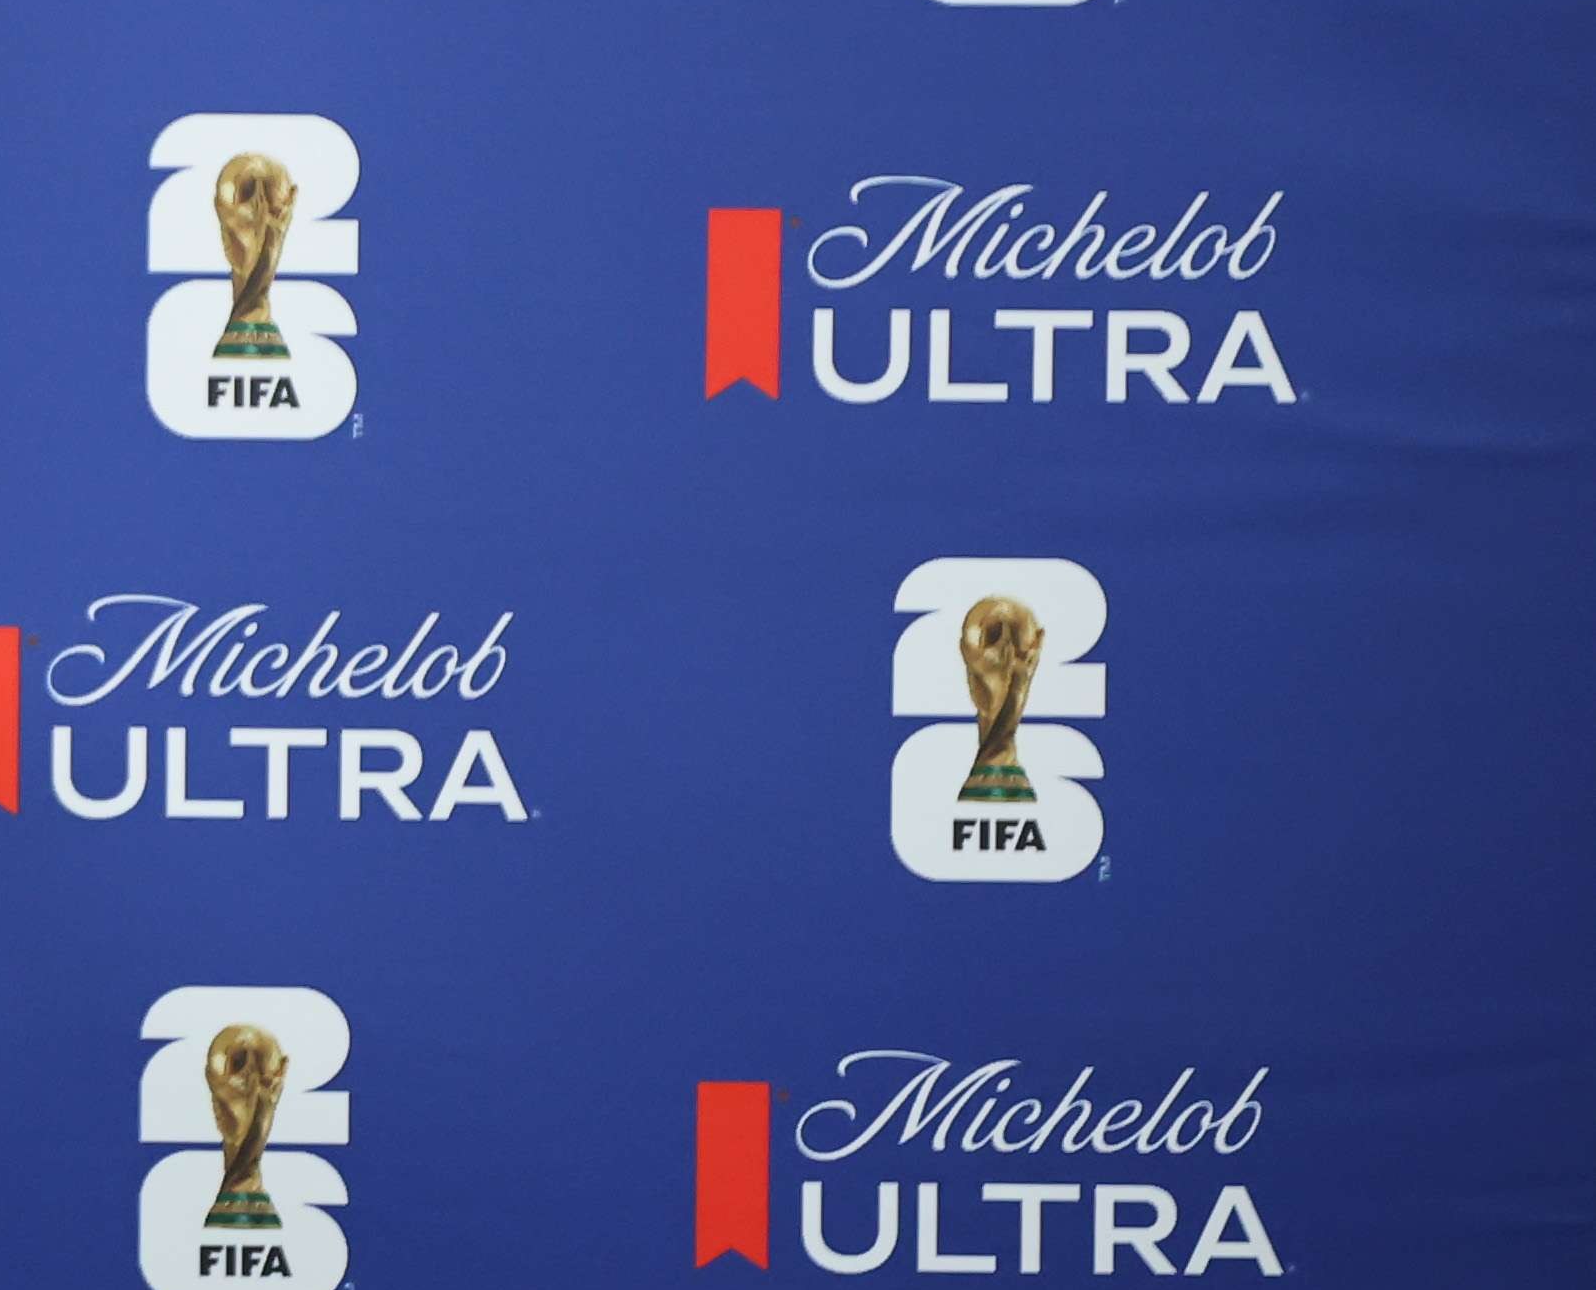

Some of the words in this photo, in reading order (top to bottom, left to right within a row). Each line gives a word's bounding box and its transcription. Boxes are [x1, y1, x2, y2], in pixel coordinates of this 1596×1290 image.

[807, 176, 1283, 288] Michelob
[207, 376, 299, 408] FIFA
[813, 309, 1296, 403] ULTRA
[47, 594, 513, 706] Michelob
[52, 726, 527, 821] ULTRA
[952, 819, 1046, 851] FIFA
[796, 1050, 1268, 1161] Michelob
[199, 1245, 291, 1278] FIFA
[802, 1181, 1283, 1276] ULTRA
